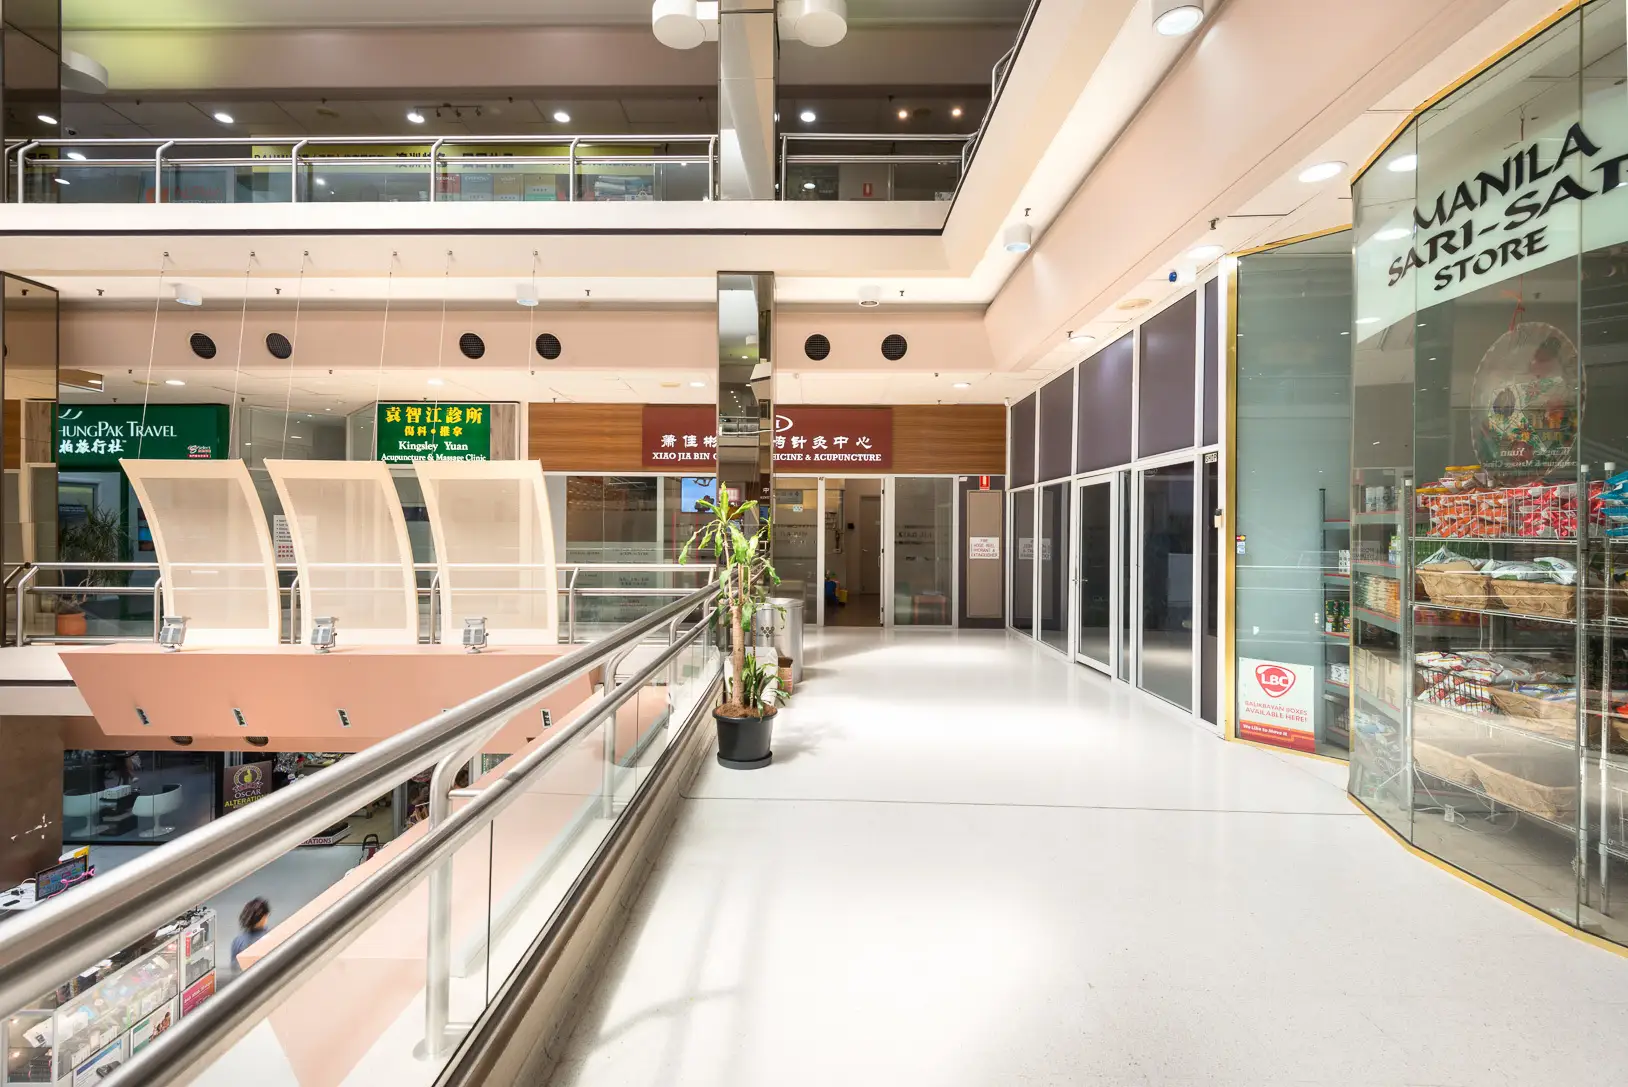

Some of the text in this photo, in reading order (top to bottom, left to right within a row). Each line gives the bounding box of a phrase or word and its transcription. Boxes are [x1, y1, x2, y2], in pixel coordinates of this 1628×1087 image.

[1413, 122, 1602, 229] MANILA
[1434, 225, 1550, 291] STORE
[126, 421, 178, 437] TRAVEL
[398, 440, 469, 452] Kingsley Yuan
[381, 453, 426, 462] Acupuncture
[426, 453, 434, 461] &
[465, 453, 486, 461] Clinic
[652, 452, 676, 460] XIAO
[677, 452, 692, 461] JIA
[693, 452, 710, 460] BIN
[814, 453, 882, 461] ACUPUNCTURE
[1261, 673, 1290, 687] LBC
[1244, 700, 1308, 716] BALIKBAYAN BOXES
[1245, 707, 1308, 723] AVAILABLE HERE!
[1268, 728, 1282, 736] Move
[234, 788, 262, 799] OSCAR
